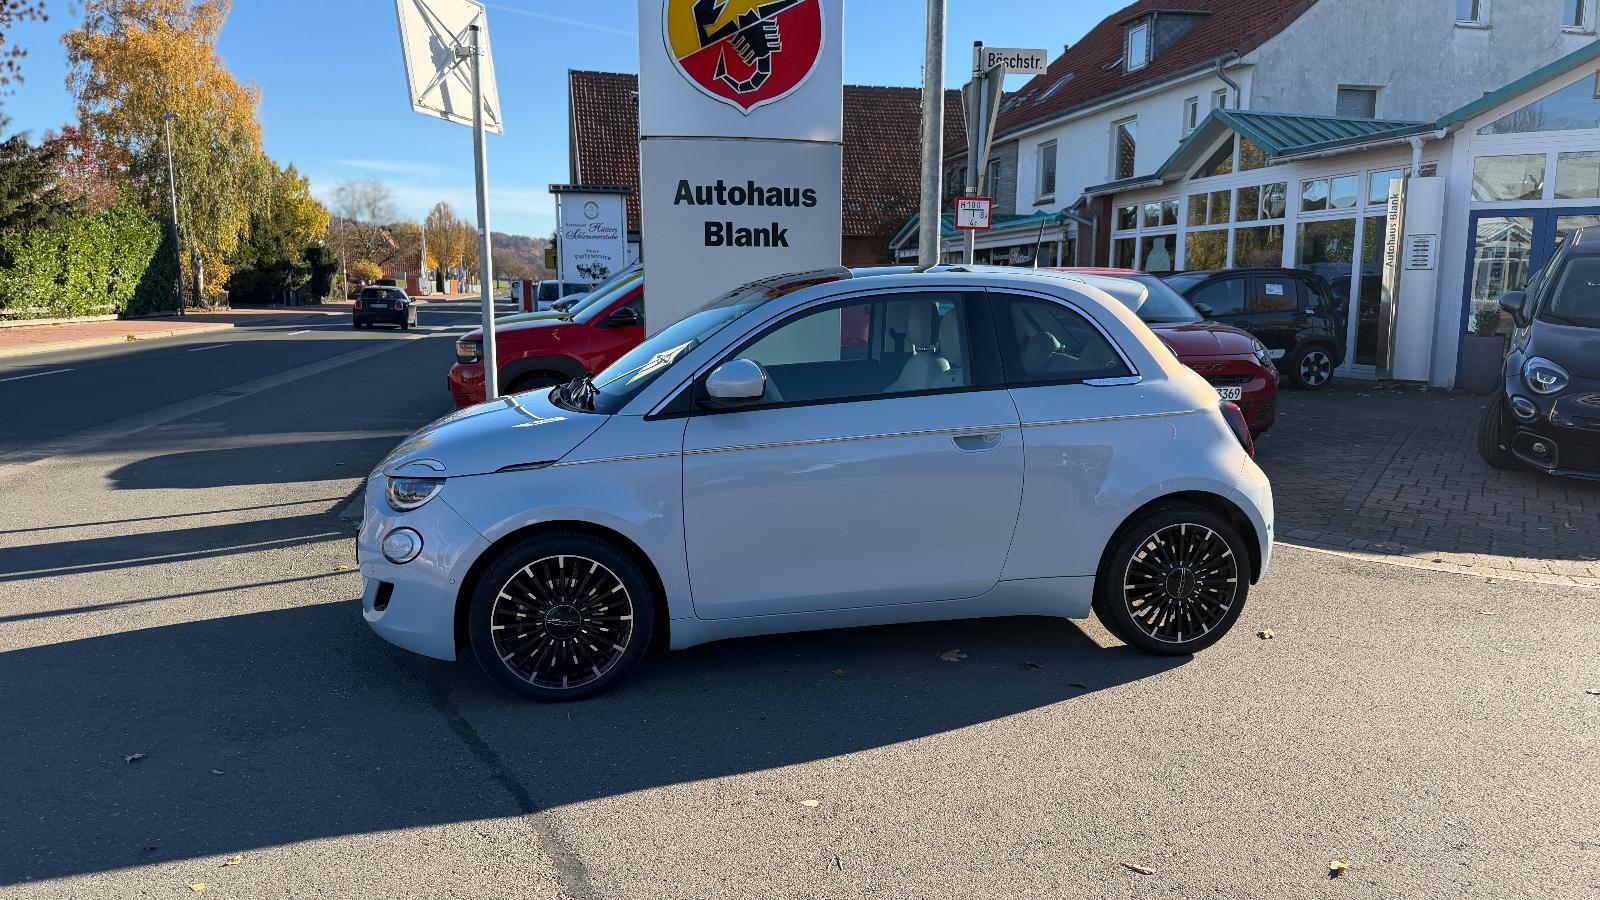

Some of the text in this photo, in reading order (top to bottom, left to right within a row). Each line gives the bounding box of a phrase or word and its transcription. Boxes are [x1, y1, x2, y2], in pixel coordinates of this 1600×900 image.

[673, 179, 818, 208] Autohaus
[704, 220, 789, 247] Blank
[1386, 193, 1399, 267] Autohaus Blank
